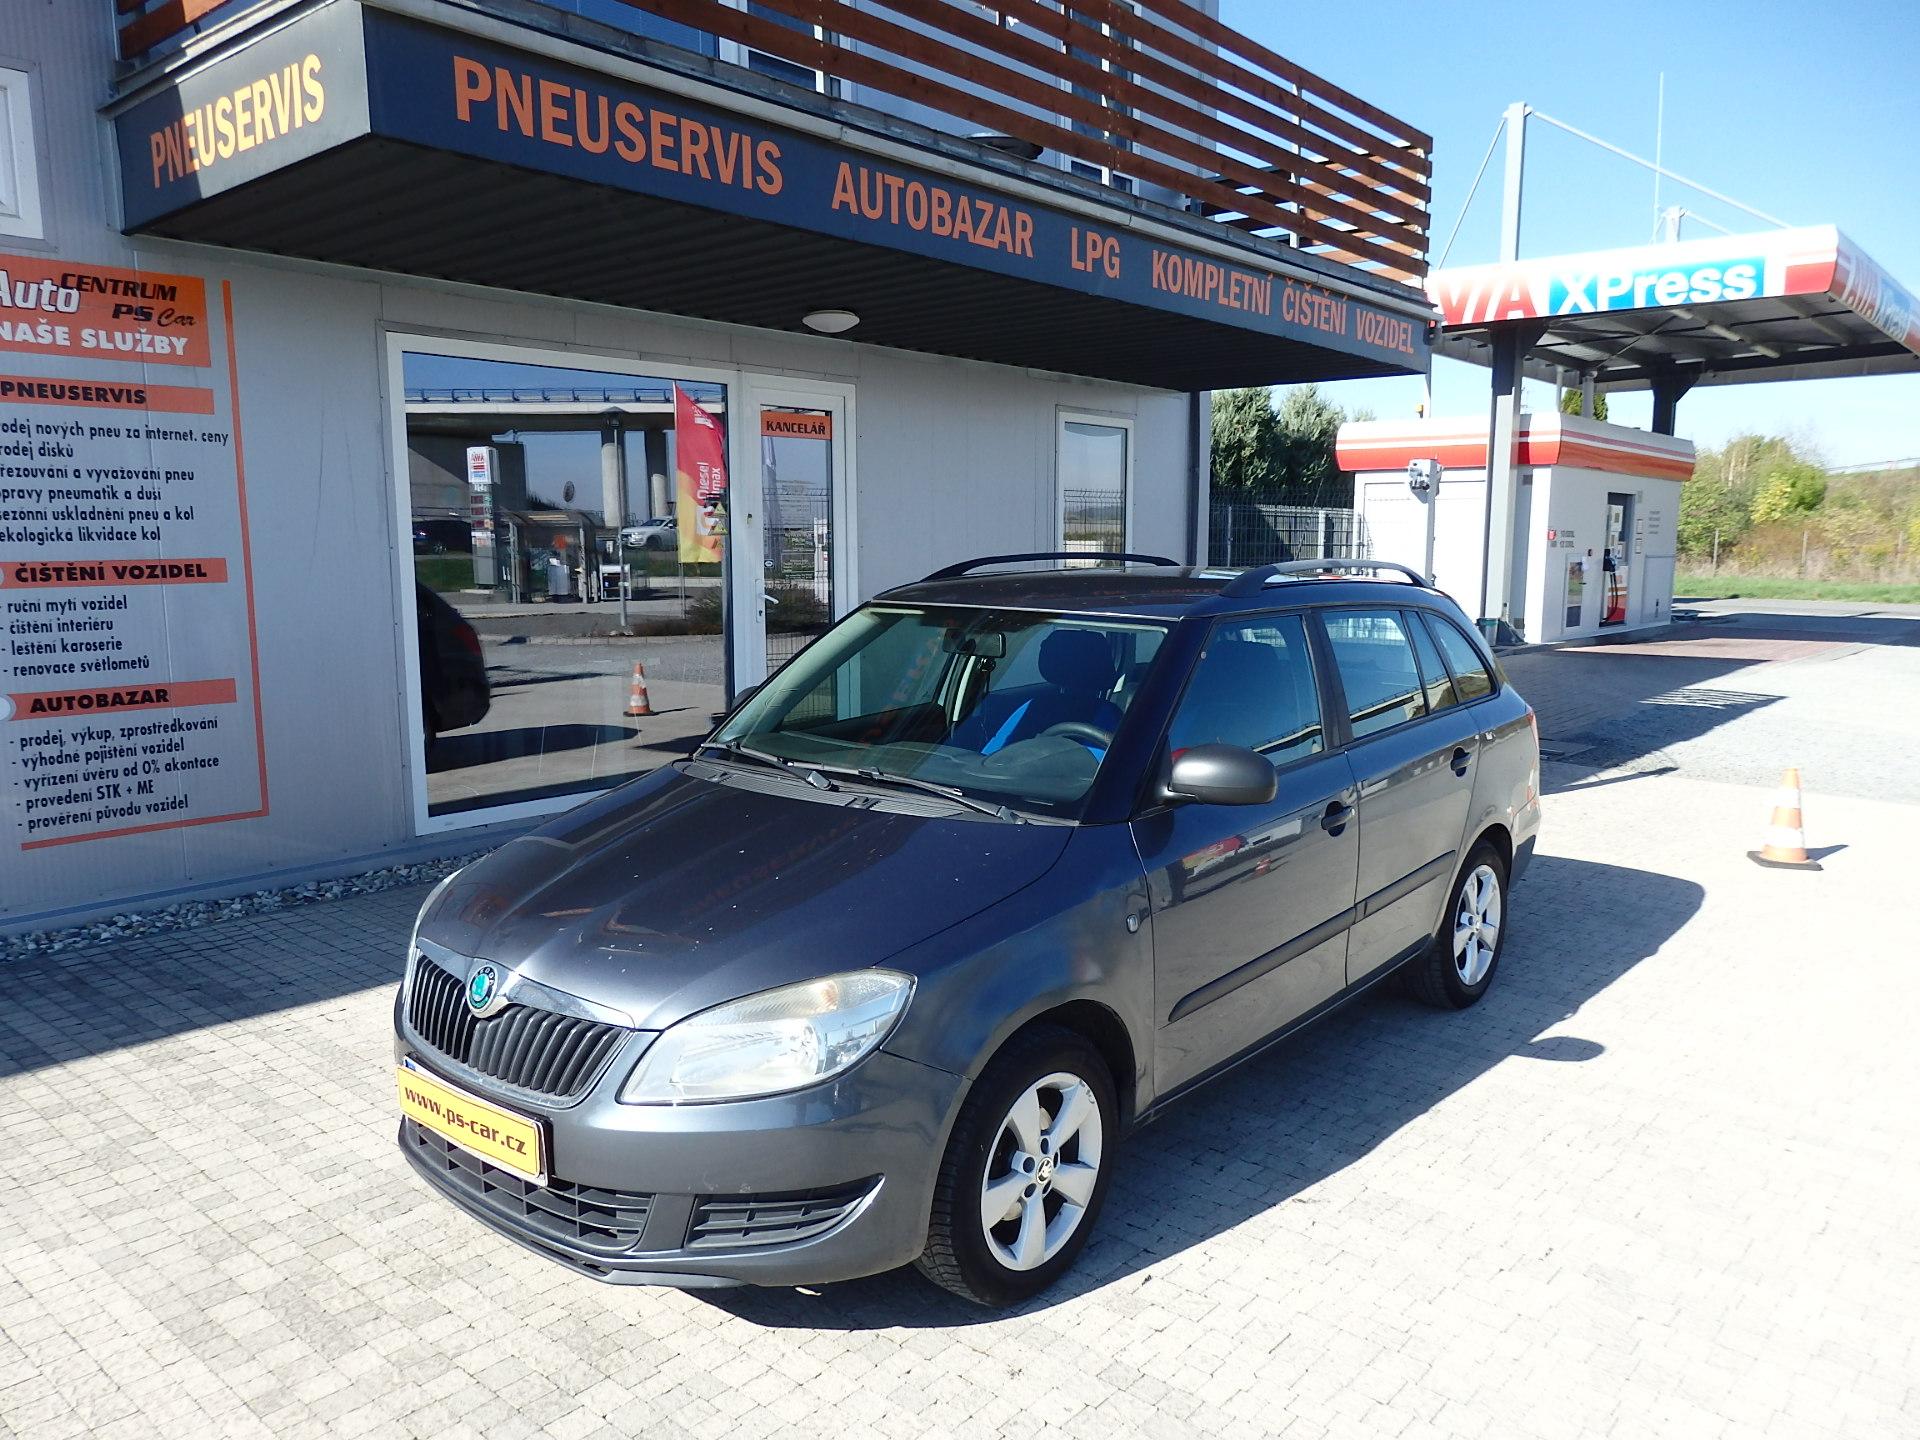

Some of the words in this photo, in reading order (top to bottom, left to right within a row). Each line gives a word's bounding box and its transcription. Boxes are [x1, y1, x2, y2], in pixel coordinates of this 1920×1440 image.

[150, 54, 325, 189] PNEUSERVIS
[454, 55, 783, 195] PNEUSERVIS
[831, 161, 1033, 258] AUTOBAZAR
[1071, 227, 1120, 279] LPG
[61, 273, 177, 302] CENTRUM
[1152, 250, 1273, 316] KOMPLETNÍ
[1282, 278, 1349, 335] ČIŠTĚNÍ
[1356, 308, 1414, 354] VOZIDEL
[112, 304, 154, 322] PS
[157, 308, 197, 327] Car
[81, 328, 188, 356] SLUŽBY
[1, 381, 147, 404] PNEUSERVIS
[36, 421, 84, 439] nových
[90, 426, 120, 440] pneu
[126, 428, 141, 438] za
[146, 425, 197, 442] internet.
[201, 431, 229, 446] ceny
[766, 420, 827, 436] KANCELÁŘ
[73, 467, 82, 479] a
[86, 466, 161, 483] vyvažování
[165, 469, 195, 484] pneu
[0, 488, 43, 503] pravy
[48, 485, 119, 503] pneumatik
[124, 489, 132, 500] a
[137, 485, 162, 501] duší
[52, 505, 125, 521] uskladnění
[129, 509, 159, 524] pneu
[164, 509, 171, 520] a
[175, 505, 194, 521] kol
[78, 526, 137, 542] likvidace
[141, 526, 161, 541] kol
[15, 562, 105, 582] ČIŠTĚNÍ
[112, 564, 207, 580] VOZIDEL
[7, 598, 41, 613] ruční
[46, 597, 77, 615] mytí
[82, 595, 128, 611] vozidel
[9, 618, 53, 634] čištění
[57, 616, 114, 633] interiéru
[11, 639, 57, 655] leštění
[61, 636, 123, 653] karoserie
[13, 662, 76, 677] renovace
[80, 655, 150, 673] světlometů
[30, 689, 170, 713] AUTOBAZAR
[20, 729, 66, 751] prodej,
[71, 727, 115, 746] výkup,
[120, 717, 218, 738] zprostředkování
[22, 751, 80, 771] výhodné
[85, 744, 137, 763] pojištění
[142, 737, 185, 754] vozidel
[24, 771, 79, 792] vyřízení
[83, 764, 118, 781] úvěru
[123, 761, 138, 777] od
[142, 760, 160, 775] 0%
[164, 756, 219, 772] akontace
[26, 791, 92, 813] provedení
[97, 782, 121, 800] STK
[126, 785, 133, 795] +
[28, 809, 92, 833] prověření
[96, 802, 141, 822] původu
[146, 794, 188, 813] vozidel
[405, 1087, 527, 1155] www.ps-car.cz
